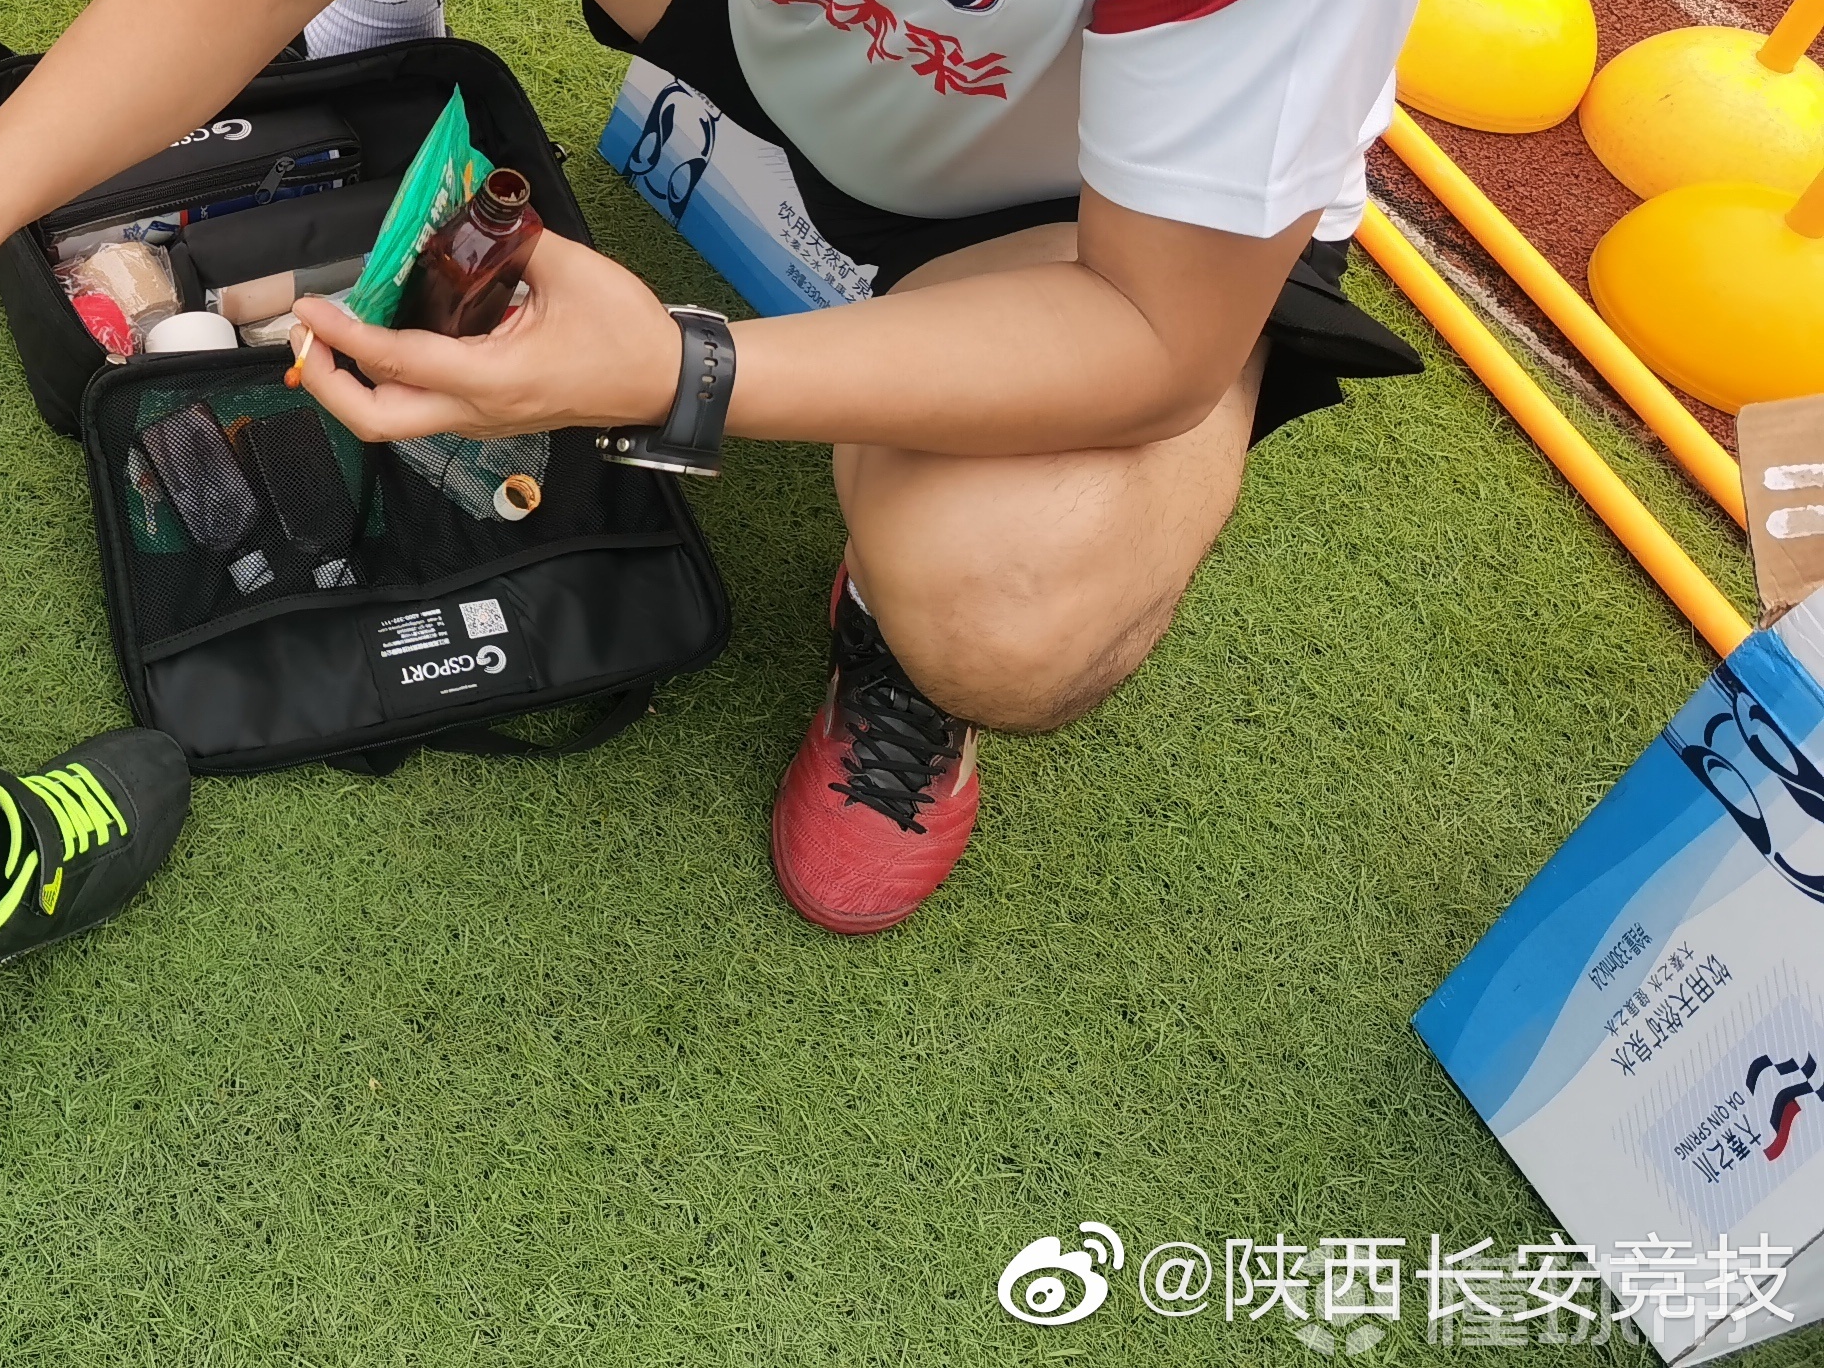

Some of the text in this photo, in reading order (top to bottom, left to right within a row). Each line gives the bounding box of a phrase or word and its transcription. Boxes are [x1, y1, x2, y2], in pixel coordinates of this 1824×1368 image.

[400, 654, 476, 685] GSPORT
[1603, 940, 1695, 1037] 大秦之水 健康之水
[1610, 953, 1734, 1077] 饮用天然矿泉水
[1673, 1090, 1746, 1161] DA QIN SPRING
[1691, 1113, 1762, 1184] 大秦之水
